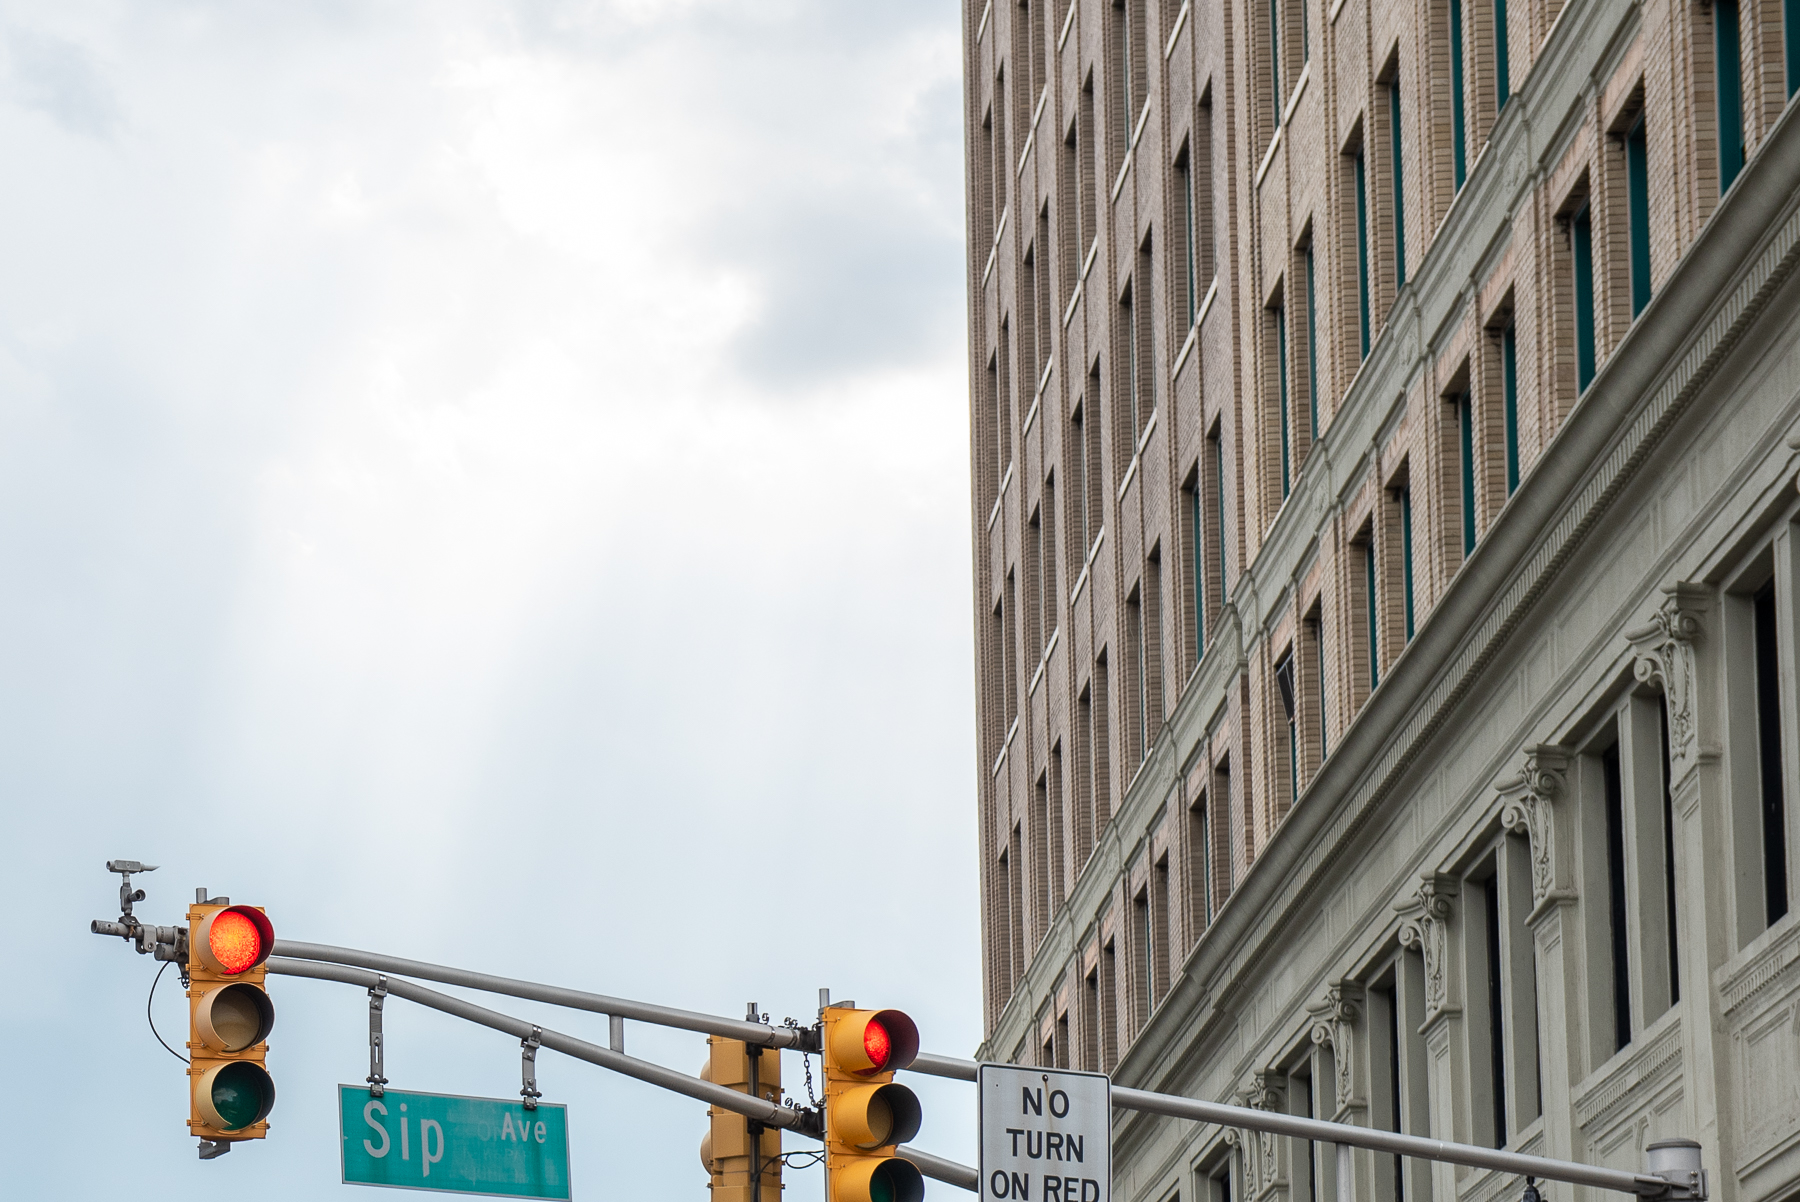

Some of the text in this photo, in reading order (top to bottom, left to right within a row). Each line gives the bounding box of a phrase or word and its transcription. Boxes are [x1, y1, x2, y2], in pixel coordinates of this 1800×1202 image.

[1022, 1086, 1070, 1119] NO
[363, 1100, 547, 1178] Sip Ave
[1005, 1127, 1084, 1164] TURN
[990, 1169, 1029, 1202] ON
